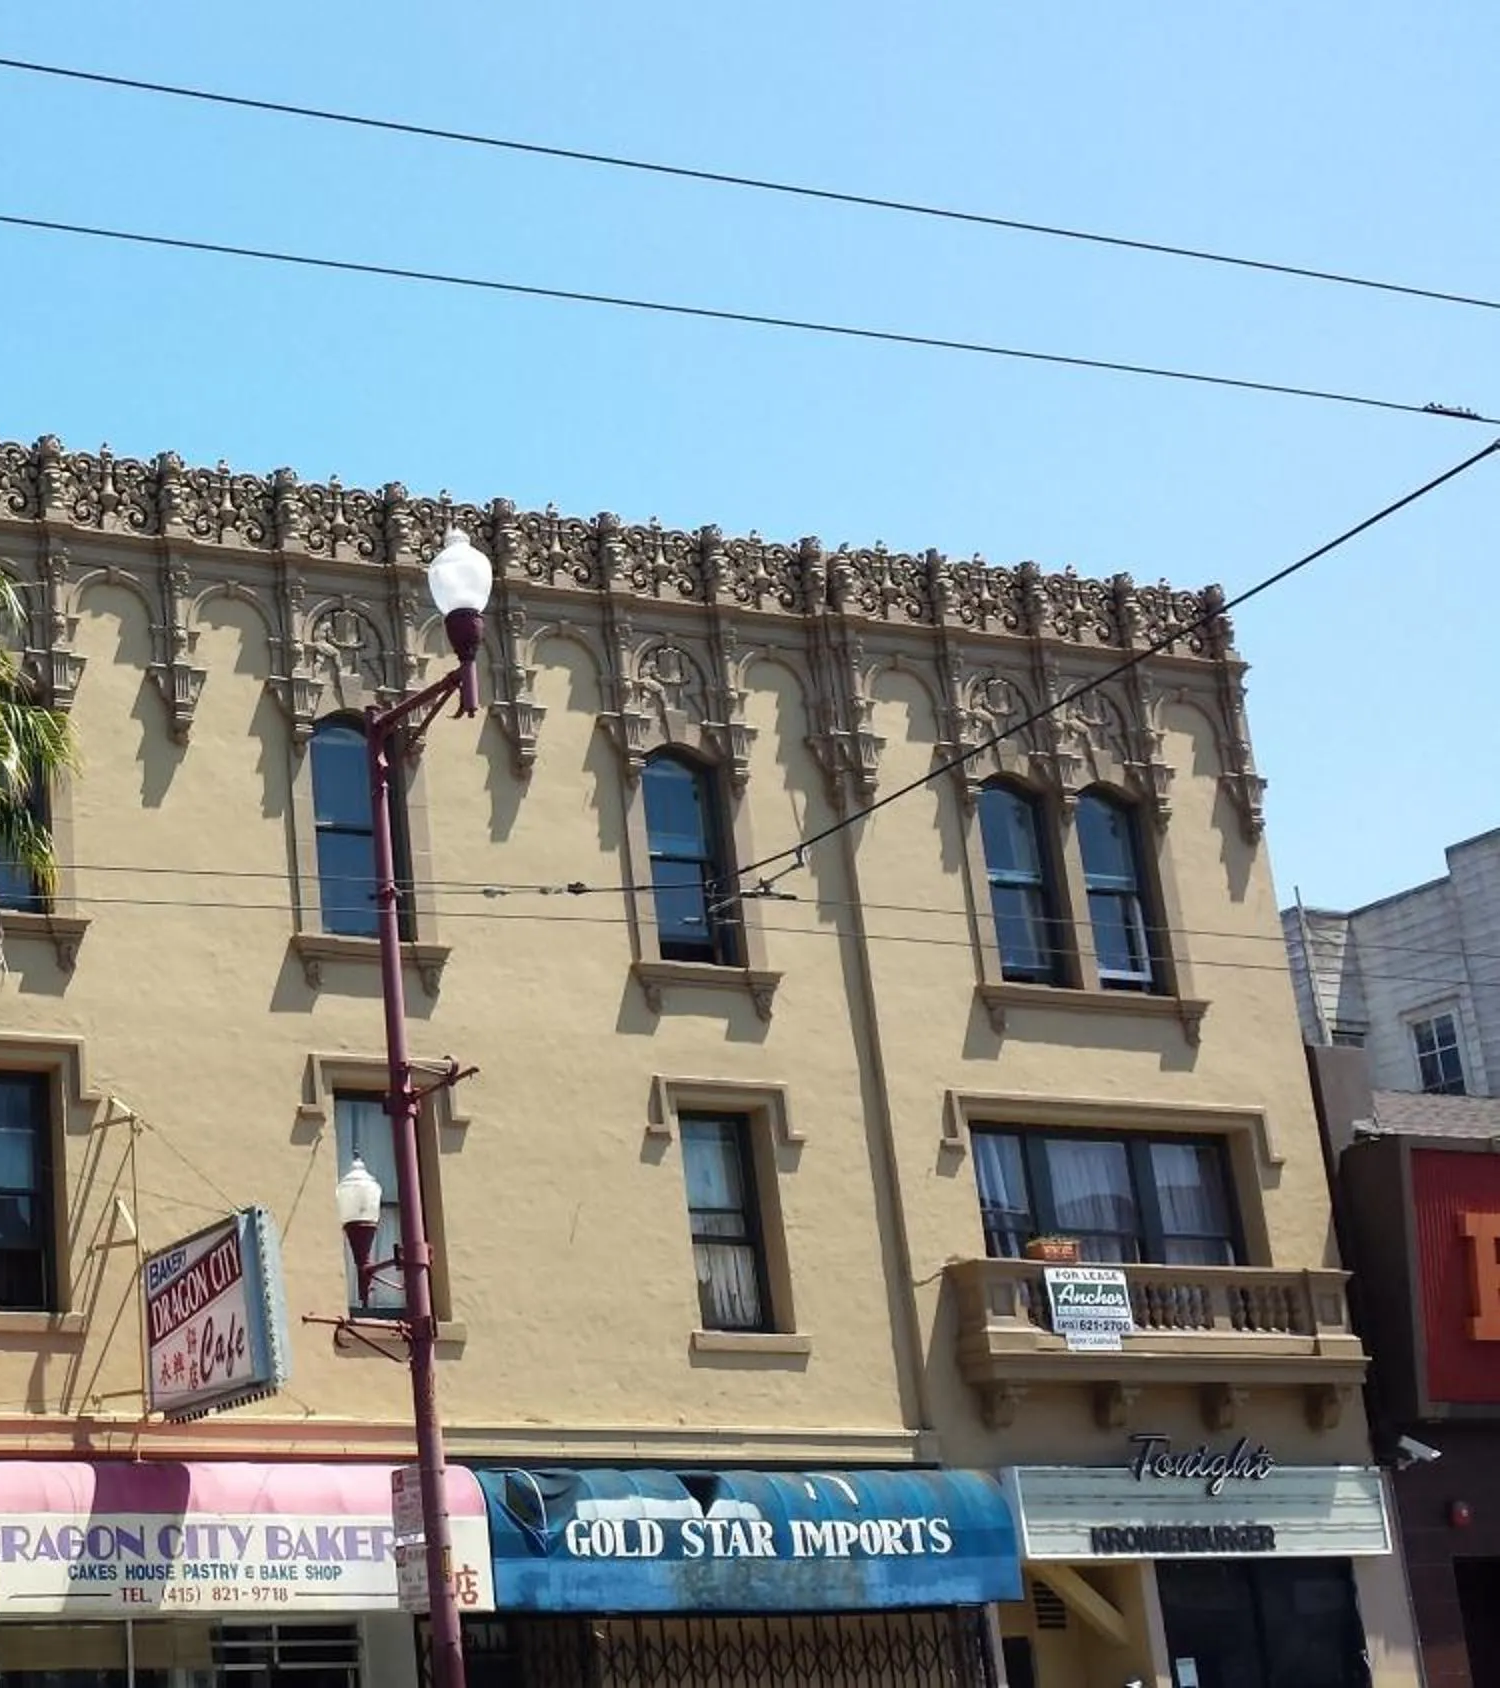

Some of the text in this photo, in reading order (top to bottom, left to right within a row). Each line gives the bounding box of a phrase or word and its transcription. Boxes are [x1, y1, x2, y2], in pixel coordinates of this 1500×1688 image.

[152, 1236, 241, 1339] DRAGON CITY
[1055, 1271, 1118, 1281] FOR LEASE
[1057, 1283, 1125, 1305] Anchor
[1079, 1319, 1130, 1332] 621-2700
[200, 1312, 244, 1384] Cafe
[1128, 1433, 1275, 1497] Tonight
[157, 1524, 254, 1561] CITY
[265, 1525, 418, 1562] BAKER
[566, 1517, 953, 1557] GOLD STAR IMPORTS
[68, 1564, 118, 1581] CAKES
[125, 1563, 174, 1581] HOUSE
[183, 1563, 239, 1580] PASTRY
[260, 1565, 298, 1580] BAKE
[305, 1564, 342, 1581] SHOP
[161, 1586, 201, 1604] (415)
